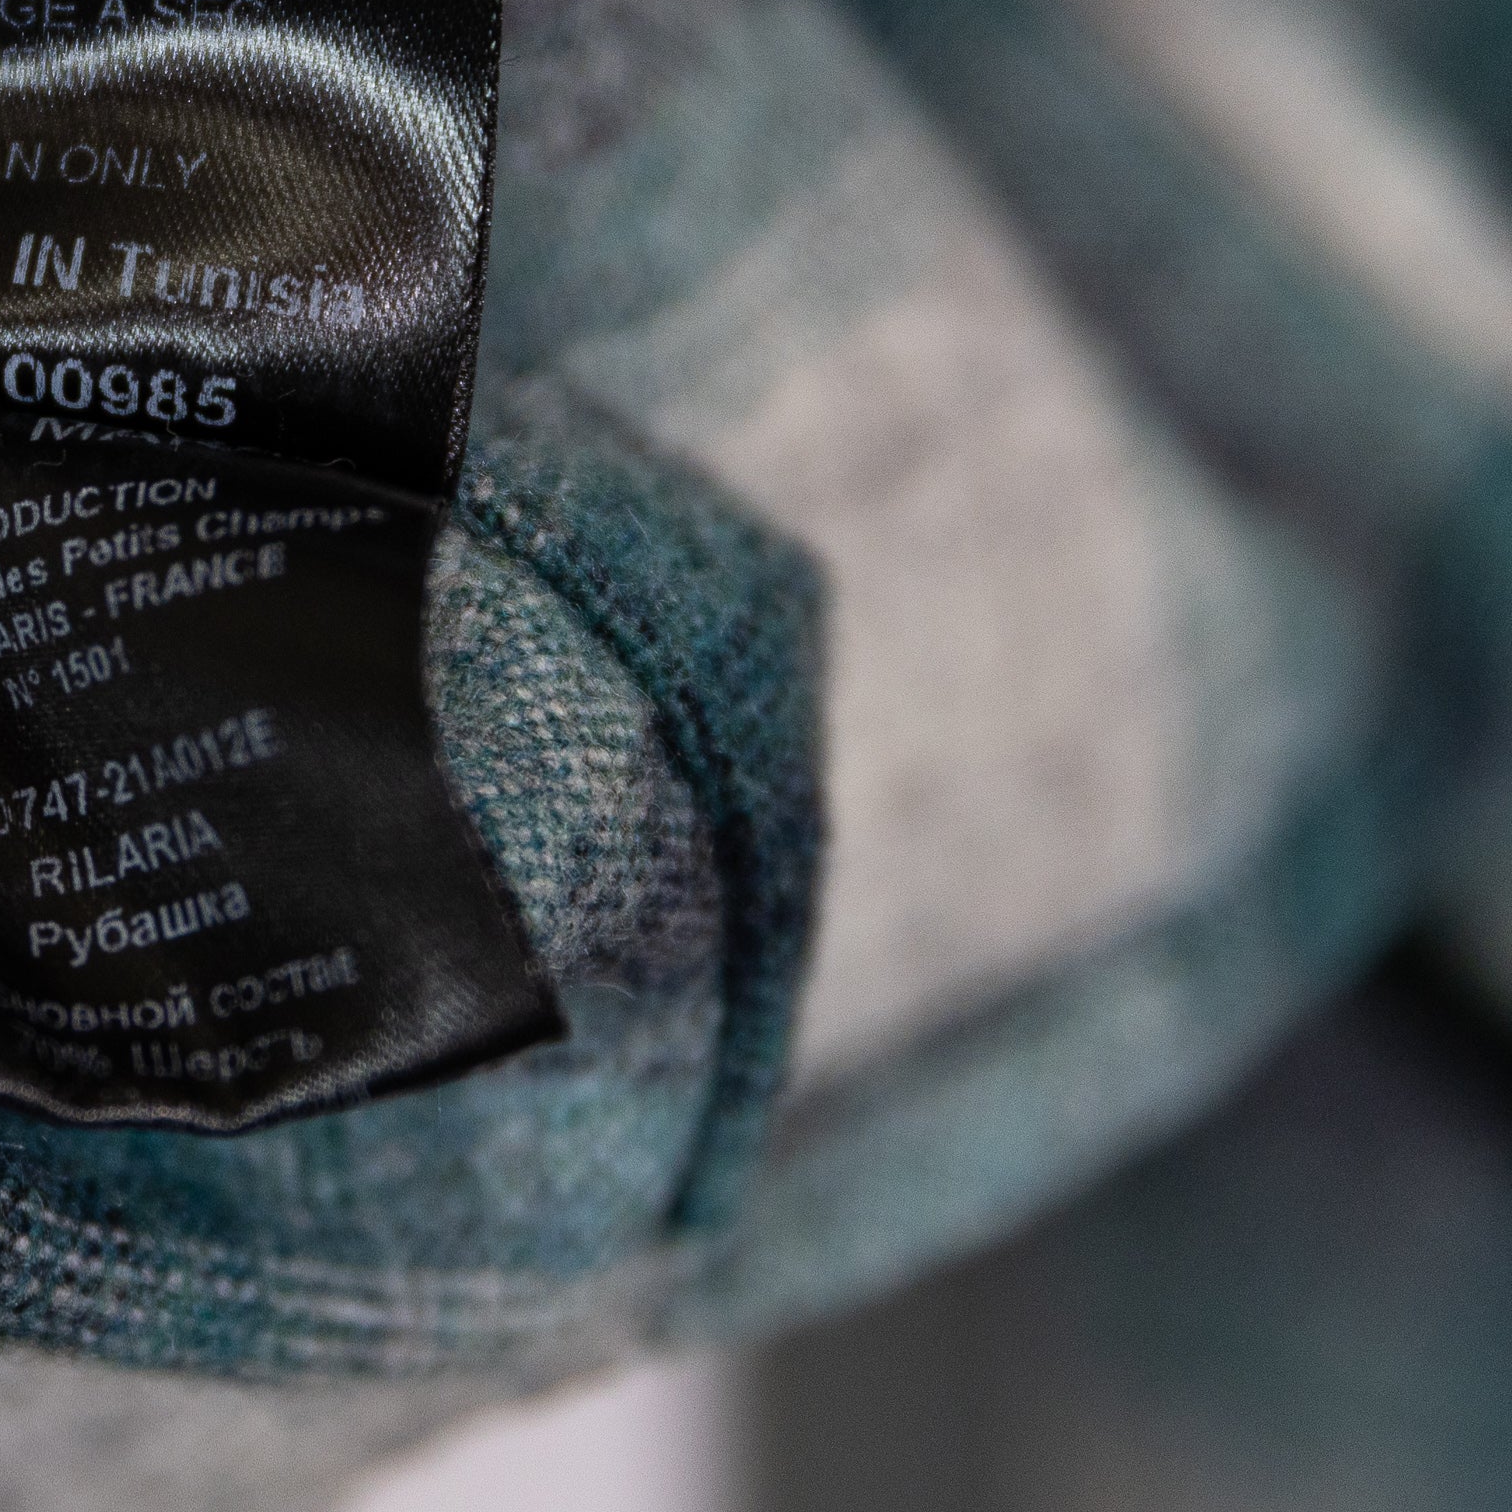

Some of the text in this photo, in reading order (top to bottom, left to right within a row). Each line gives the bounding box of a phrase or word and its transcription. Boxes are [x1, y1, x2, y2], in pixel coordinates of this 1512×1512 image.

[58, 141, 208, 190] ONLY
[13, 232, 86, 291] IN
[109, 241, 366, 330] Tunisia
[1, 351, 238, 428] 00985
[61, 521, 183, 577] Petits
[103, 540, 287, 621] FRANCE
[29, 807, 224, 898] RILARIA
[28, 880, 252, 968] Рубашка
